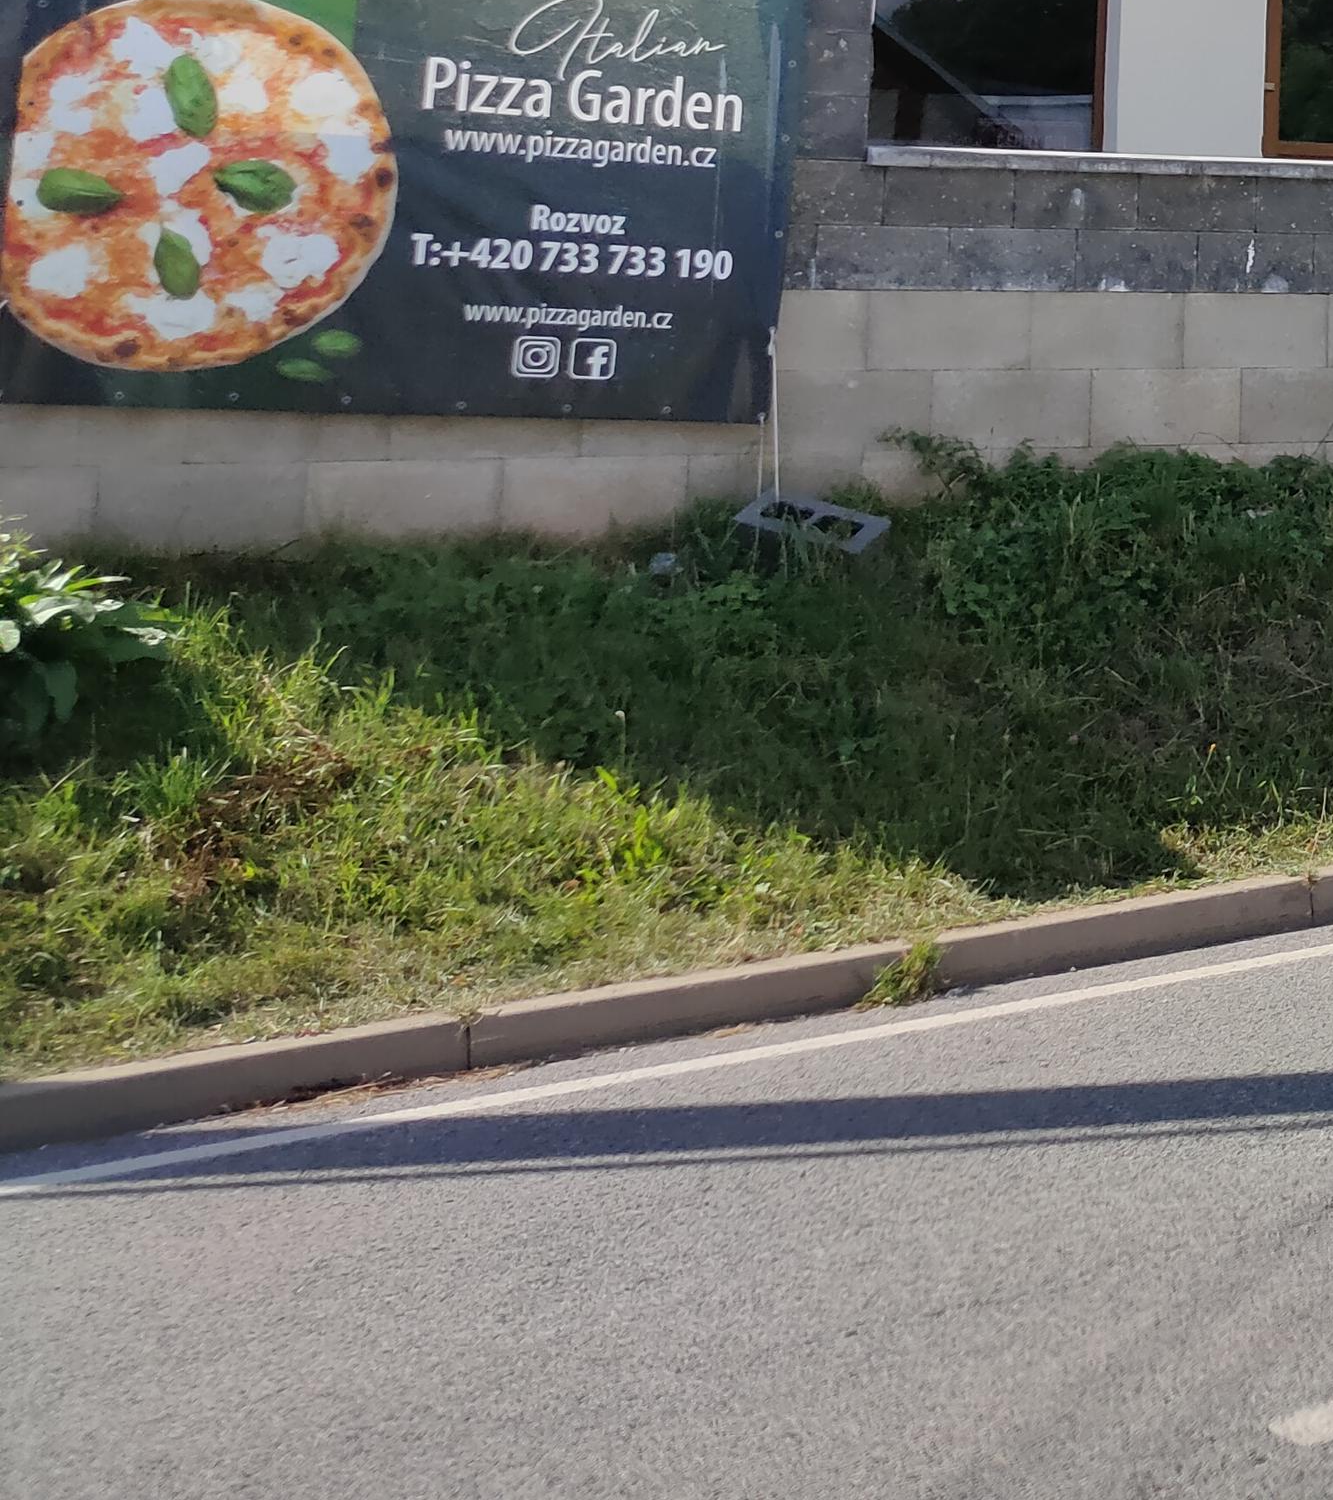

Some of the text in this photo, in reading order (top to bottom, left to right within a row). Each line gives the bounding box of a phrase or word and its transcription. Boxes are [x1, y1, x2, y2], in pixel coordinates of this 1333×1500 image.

[422, 56, 744, 132] Pizza Garden
[444, 127, 717, 168] www.pizzagarden.cz
[531, 204, 625, 235] Rozvoz
[411, 233, 733, 280] T:+420 733 733 190
[463, 300, 674, 332] www.pizzagarden.cz
